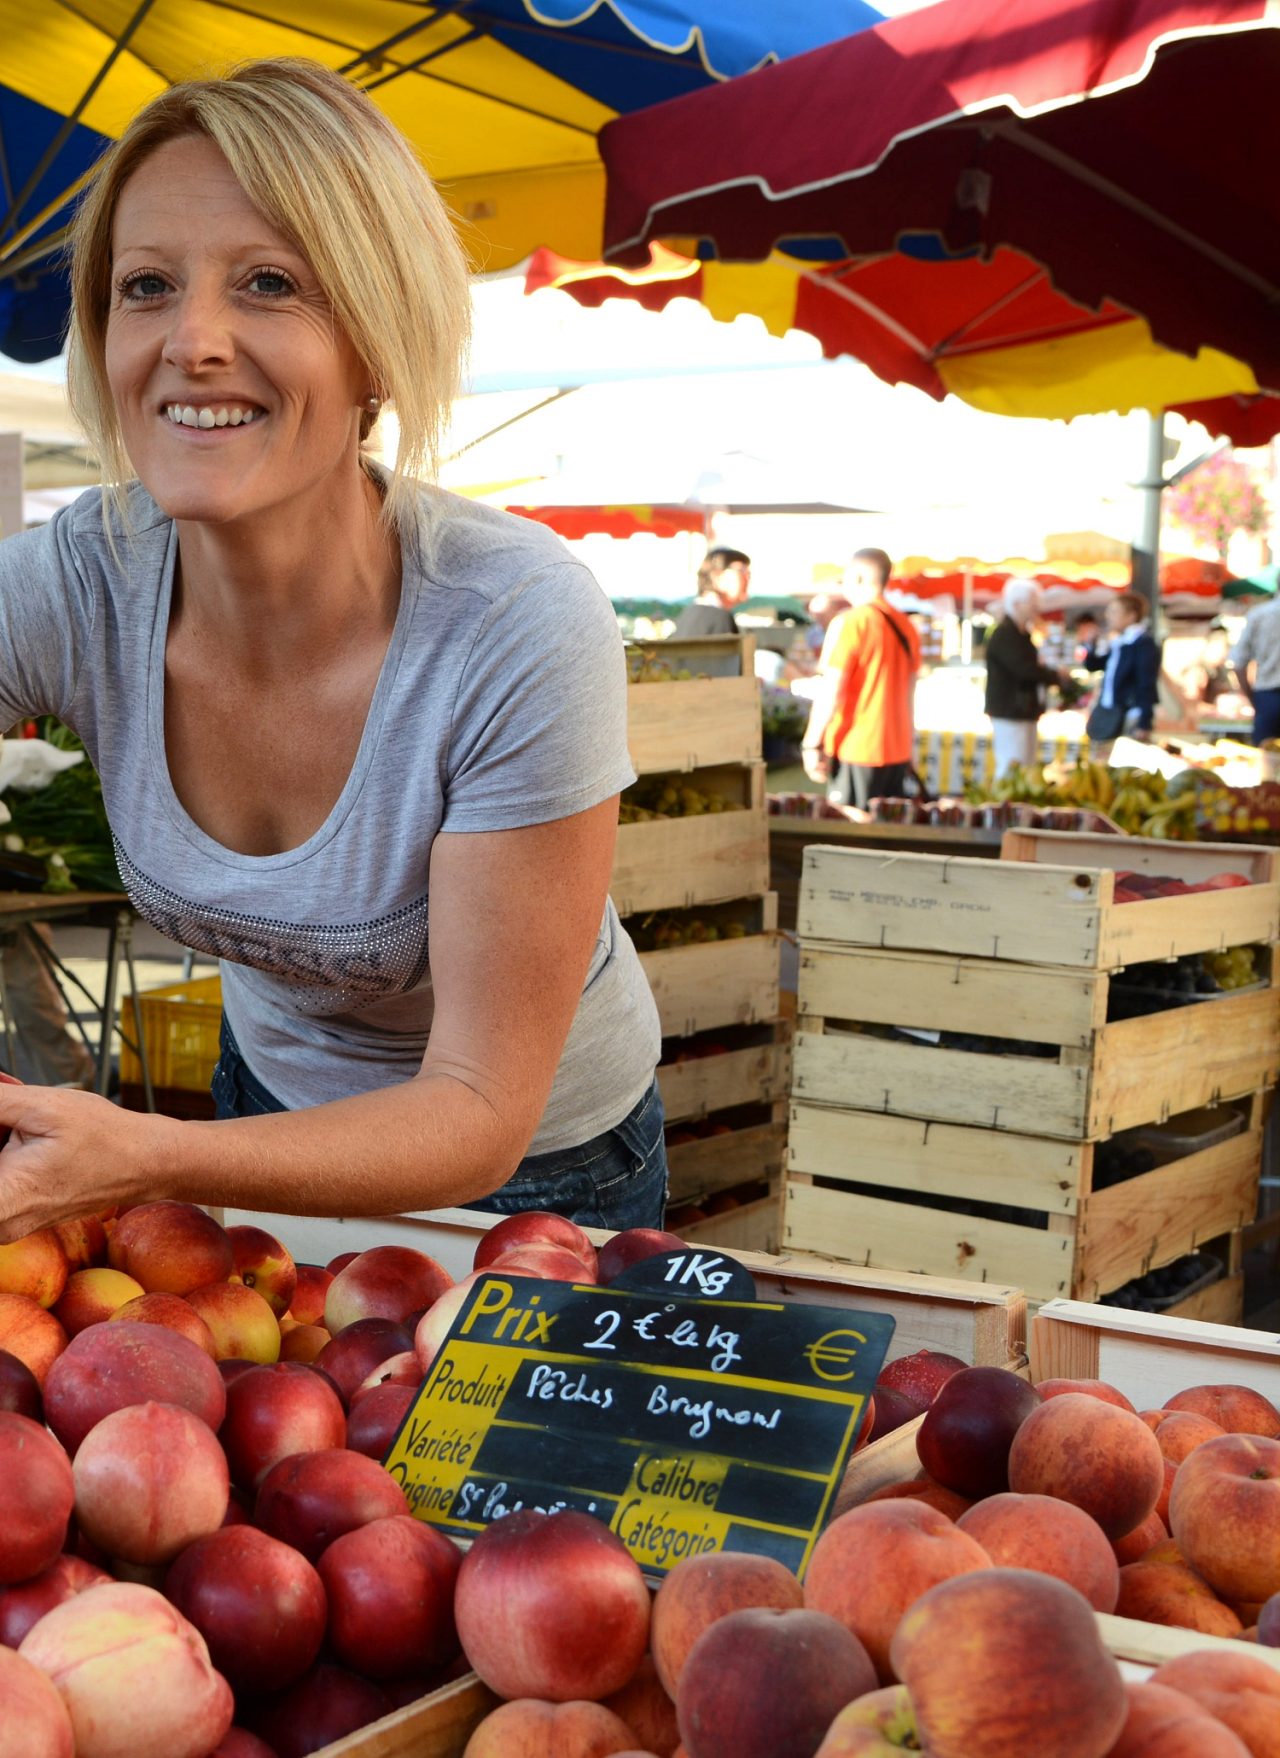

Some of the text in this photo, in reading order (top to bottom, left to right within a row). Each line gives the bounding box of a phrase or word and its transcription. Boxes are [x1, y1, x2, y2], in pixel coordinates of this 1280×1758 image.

[664, 1254, 733, 1295] 1Kg
[460, 1280, 559, 1344] Prix
[583, 1310, 620, 1350] 2
[426, 1359, 506, 1408] Produit
[405, 1418, 478, 1465] Variété
[635, 1454, 720, 1506] Calibre
[616, 1498, 718, 1565] Catégorie
